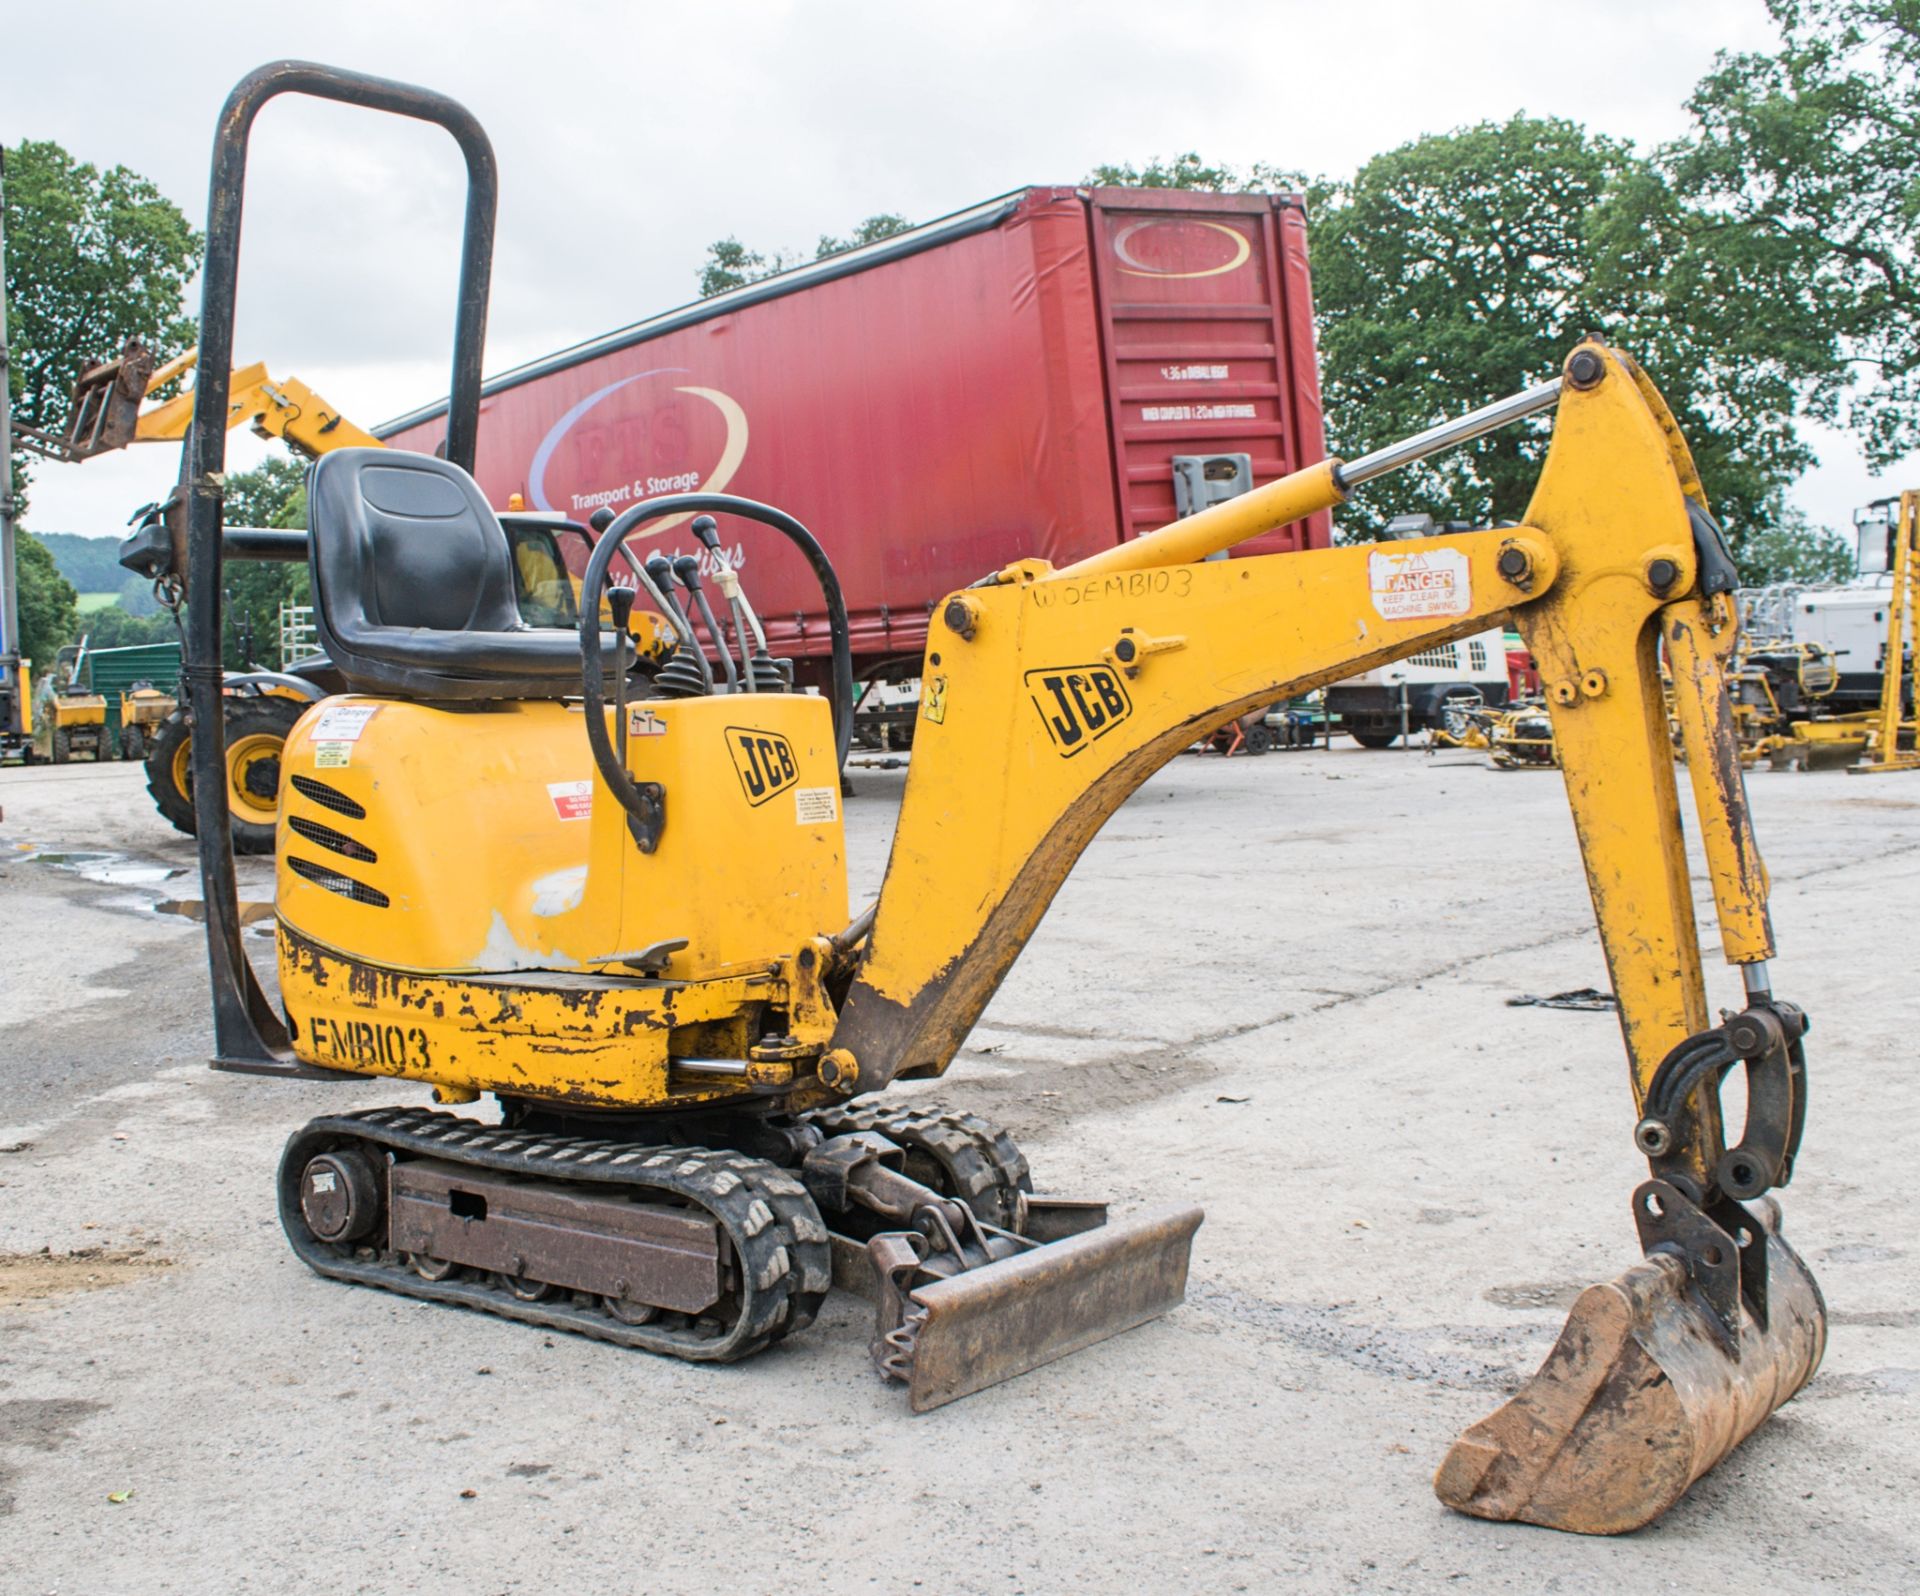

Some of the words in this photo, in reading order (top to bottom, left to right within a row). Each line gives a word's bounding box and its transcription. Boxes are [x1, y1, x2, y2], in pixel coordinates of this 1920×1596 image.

[571, 484, 630, 510] Transport
[633, 480, 644, 498] &
[646, 471, 699, 495] Storage
[1383, 594, 1405, 604] KEEP
[1410, 590, 1439, 602] CLEAR
[1444, 589, 1456, 599] OF
[1383, 603, 1423, 615] MACHINE
[1043, 671, 1125, 746] JCB
[739, 736, 795, 797] JCB
